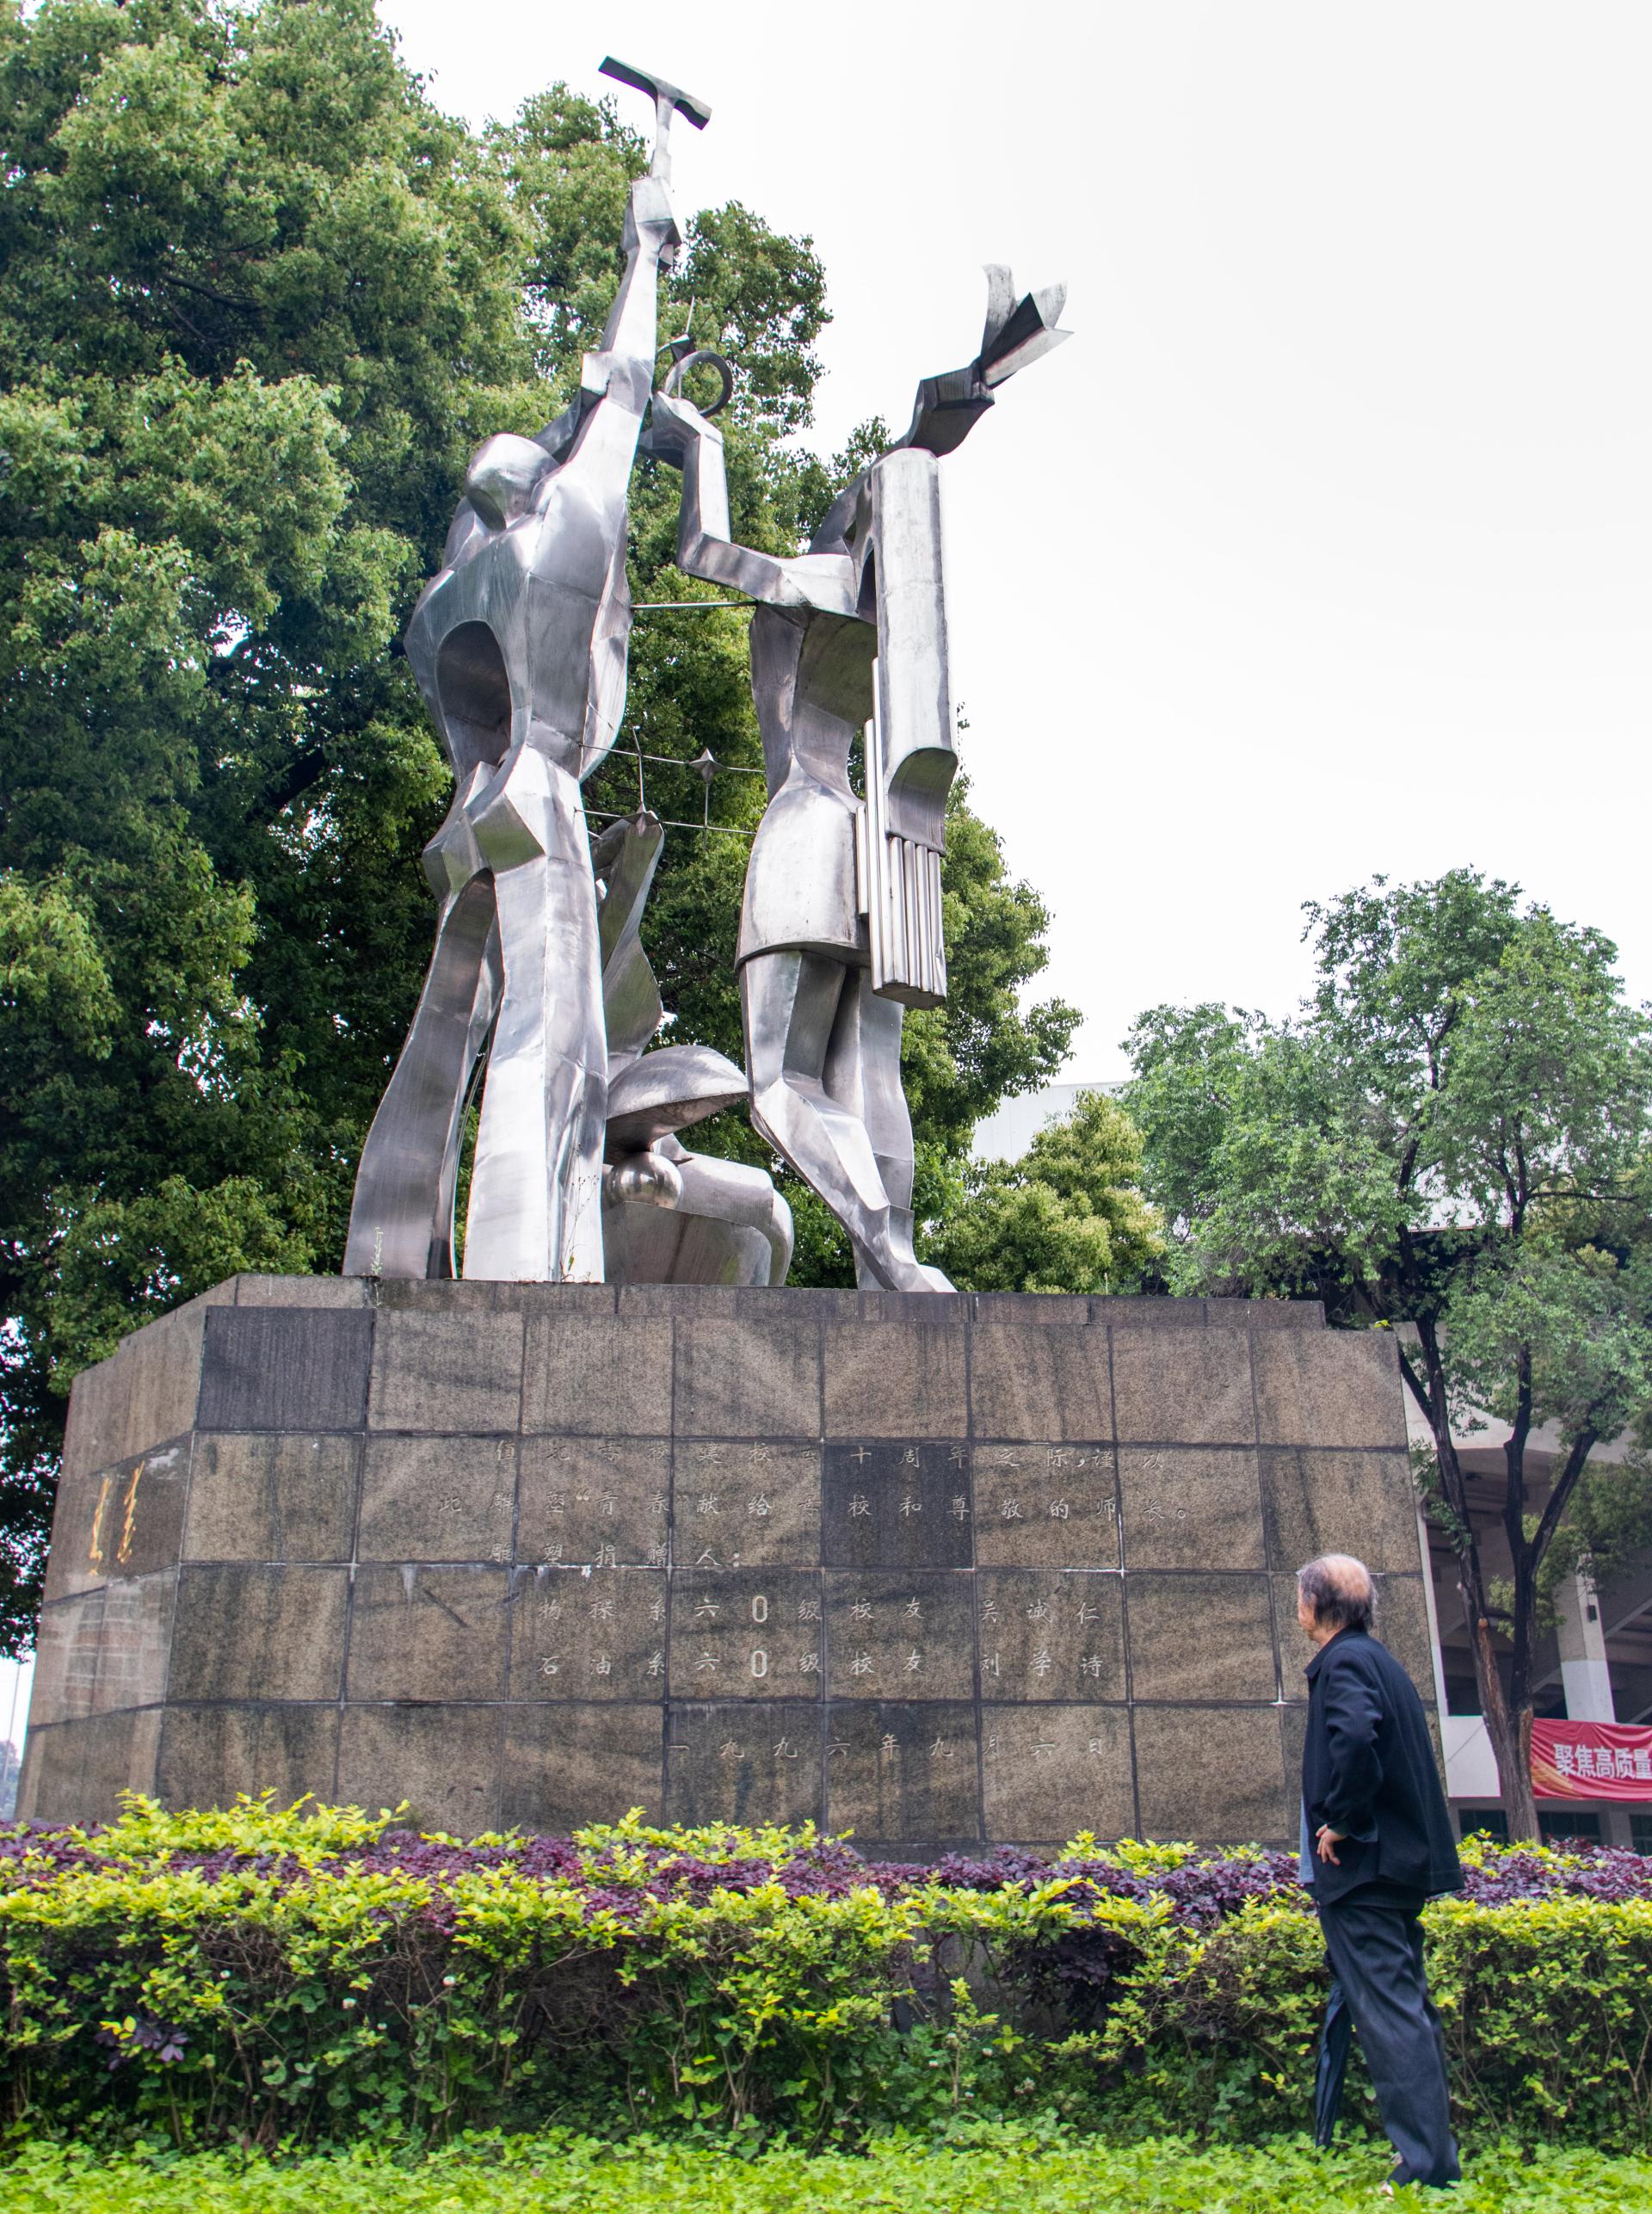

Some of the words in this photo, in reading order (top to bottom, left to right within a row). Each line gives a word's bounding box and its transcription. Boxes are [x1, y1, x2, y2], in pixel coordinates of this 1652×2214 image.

[667, 1733, 1102, 1760] 一九九六年九月六日
[1553, 1743, 1652, 1779] 聚焦高质量
